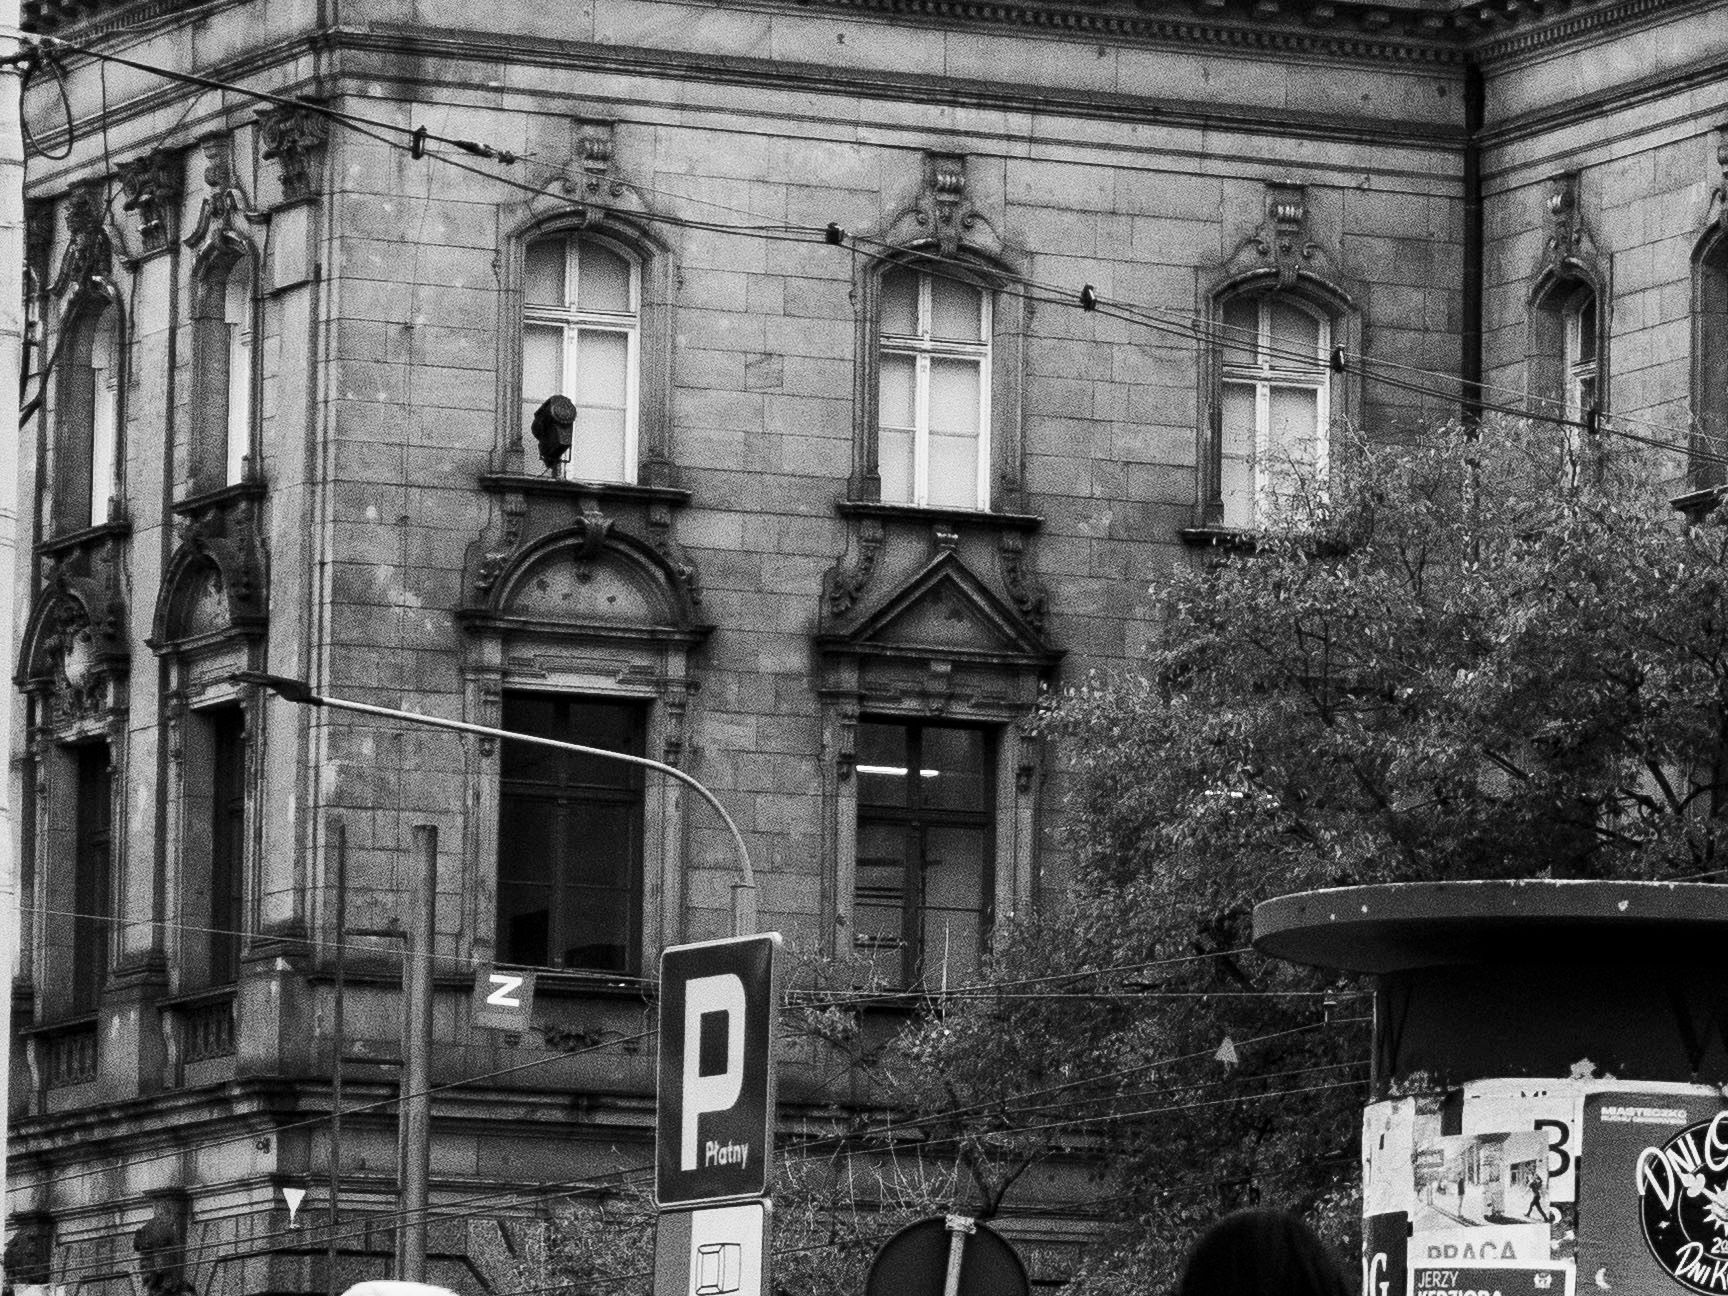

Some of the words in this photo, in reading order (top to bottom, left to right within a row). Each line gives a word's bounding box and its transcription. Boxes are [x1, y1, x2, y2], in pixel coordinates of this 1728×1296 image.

[681, 972, 746, 1172] P
[705, 1140, 749, 1169] Płatny
[1636, 1133, 1702, 1211] DNI
[1417, 1271, 1458, 1289] JERZY
